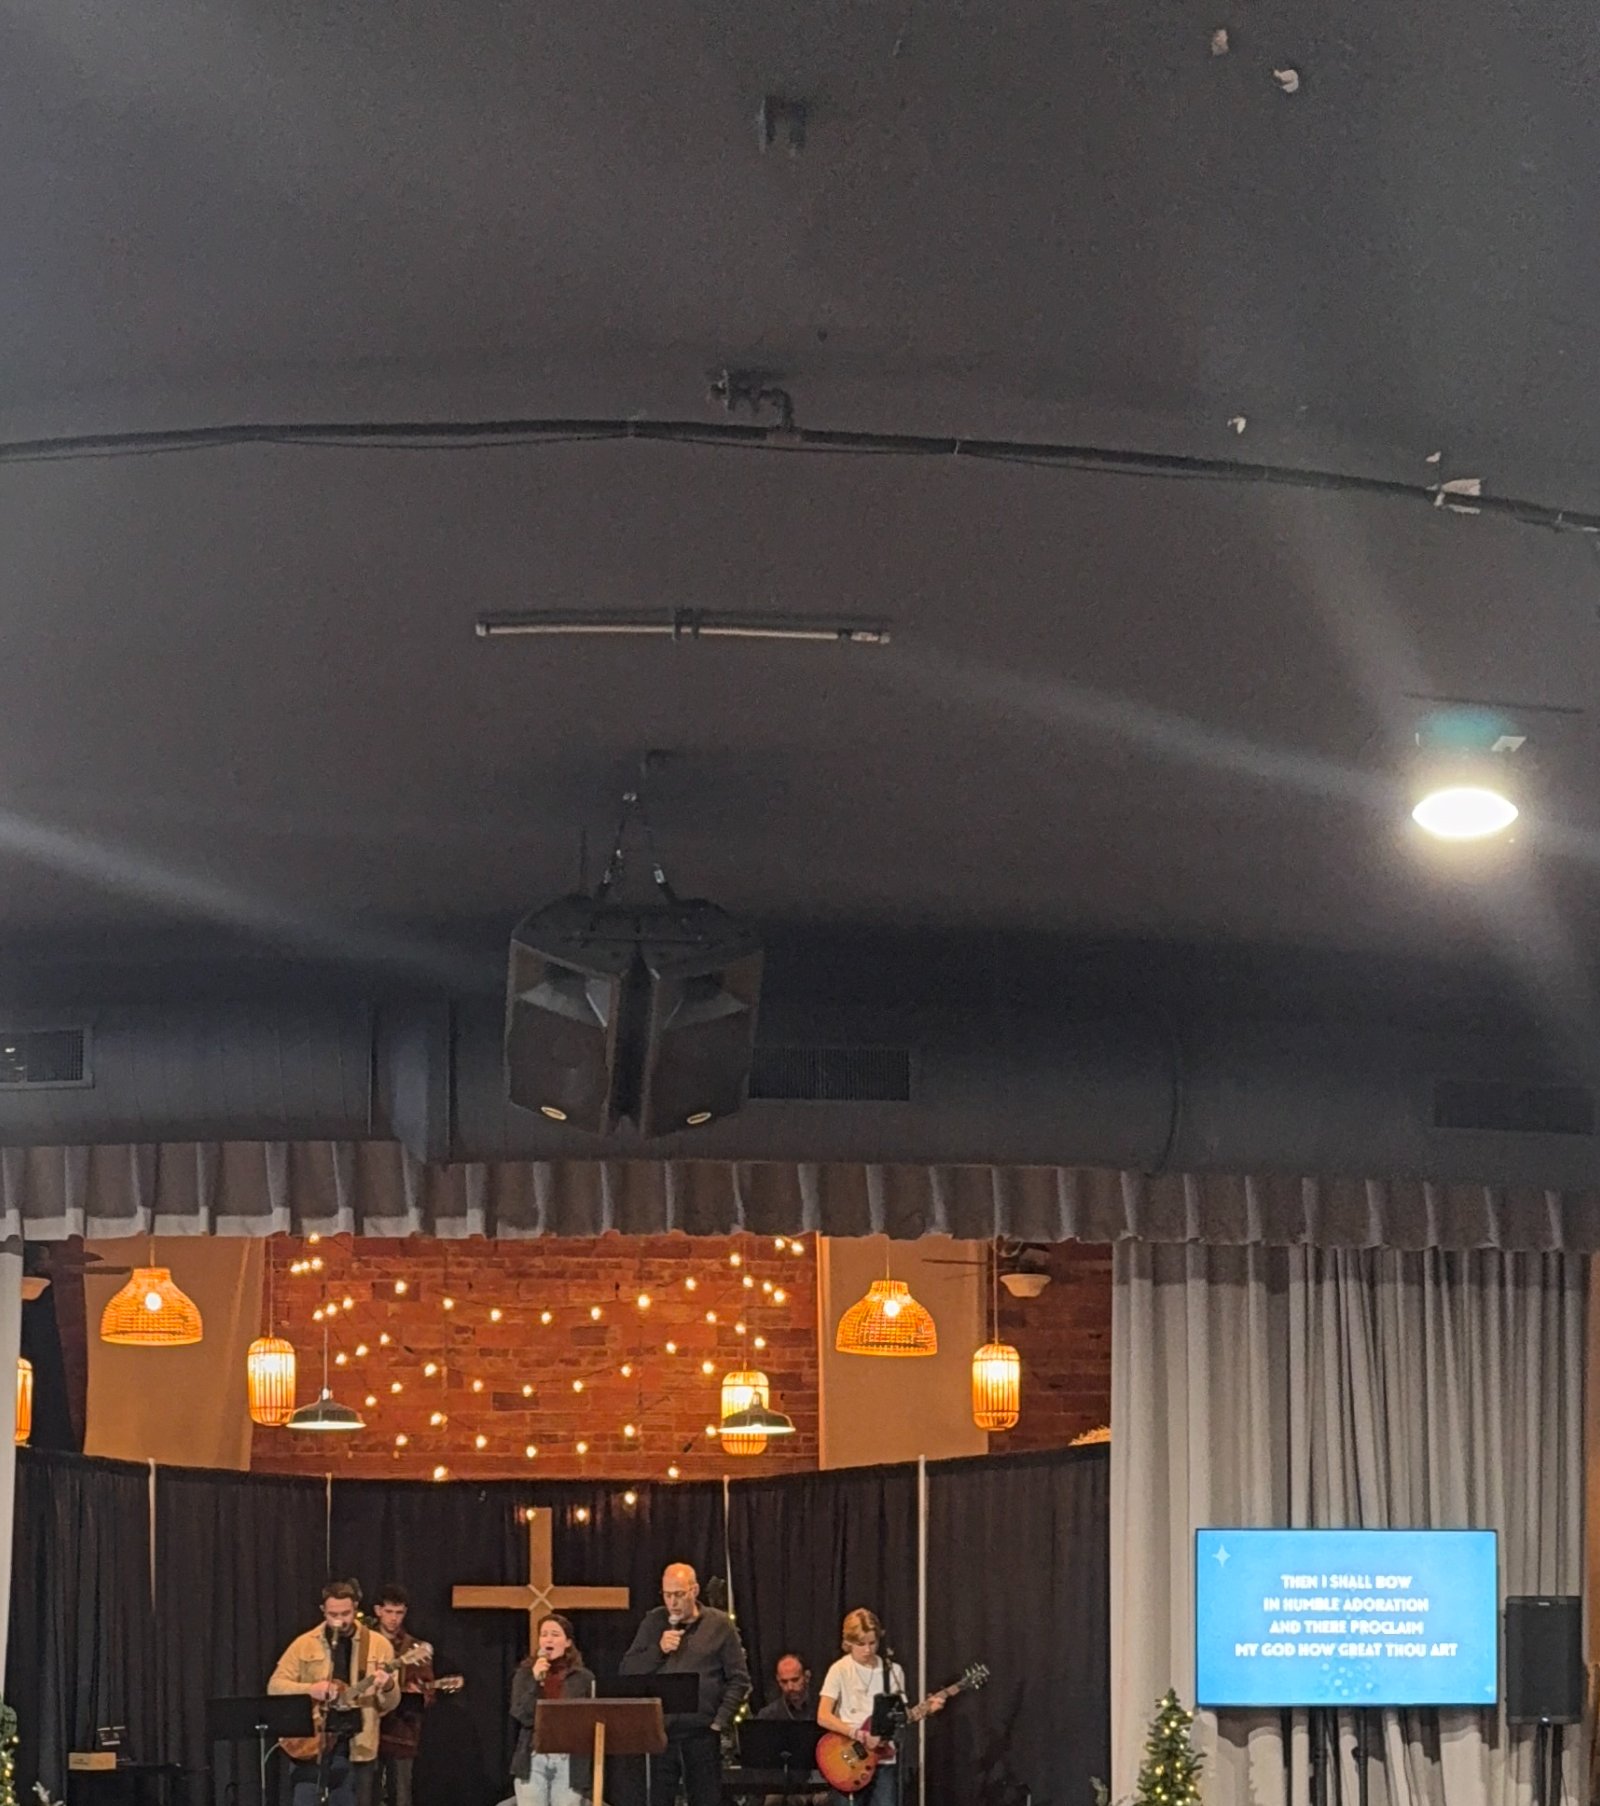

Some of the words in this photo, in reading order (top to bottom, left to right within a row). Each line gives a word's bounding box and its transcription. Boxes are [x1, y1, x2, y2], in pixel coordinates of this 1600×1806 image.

[1281, 1575, 1318, 1588] THEN
[1322, 1575, 1327, 1588] I
[1330, 1575, 1372, 1589] SHALL
[1376, 1576, 1412, 1589] BOW
[1264, 1598, 1280, 1610] IN
[1283, 1598, 1339, 1611] HUMBLE
[1343, 1598, 1429, 1612] ADORATION
[1270, 1621, 1301, 1634] AND
[1304, 1620, 1346, 1633] THERE
[1351, 1620, 1424, 1634] PROCLAIM
[1236, 1644, 1257, 1655] MY
[1262, 1644, 1295, 1655] GOD
[1299, 1644, 1335, 1656] HOW
[1339, 1643, 1381, 1656] GREAT
[1386, 1644, 1426, 1656] THOU
[1431, 1644, 1457, 1656] ART
